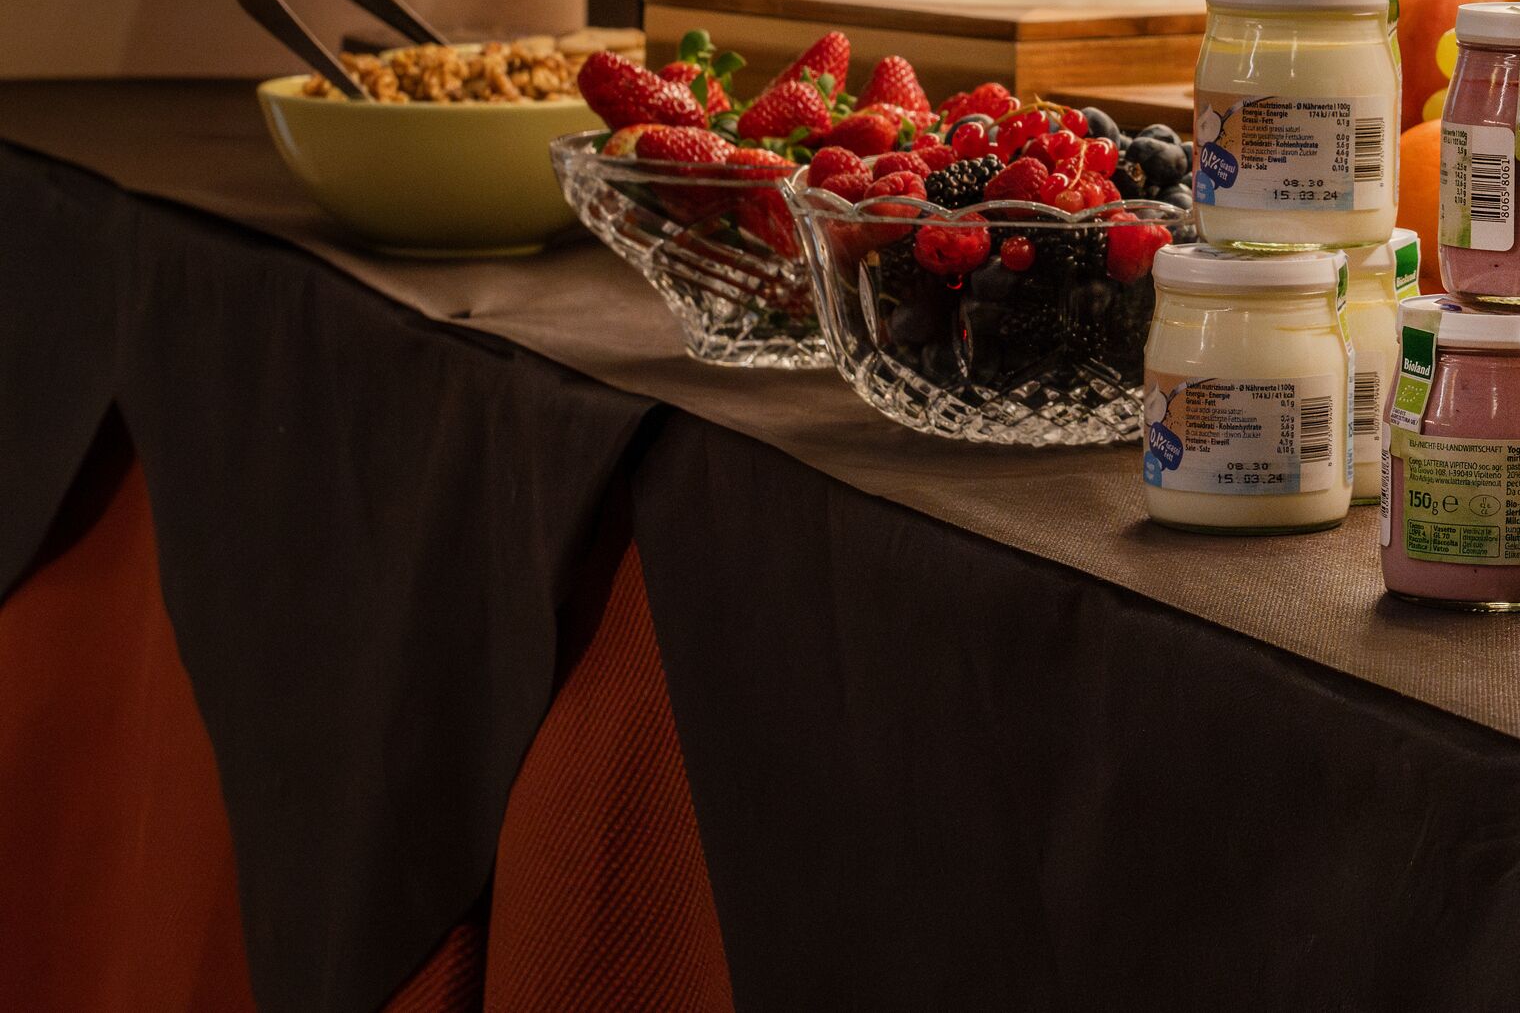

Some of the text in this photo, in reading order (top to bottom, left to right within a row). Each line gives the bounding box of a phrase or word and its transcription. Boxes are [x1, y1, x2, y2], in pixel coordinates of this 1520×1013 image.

[1404, 358, 1431, 376] Bioland
[1450, 461, 1478, 470] VIPITENO
[1506, 488, 1516, 496] Da
